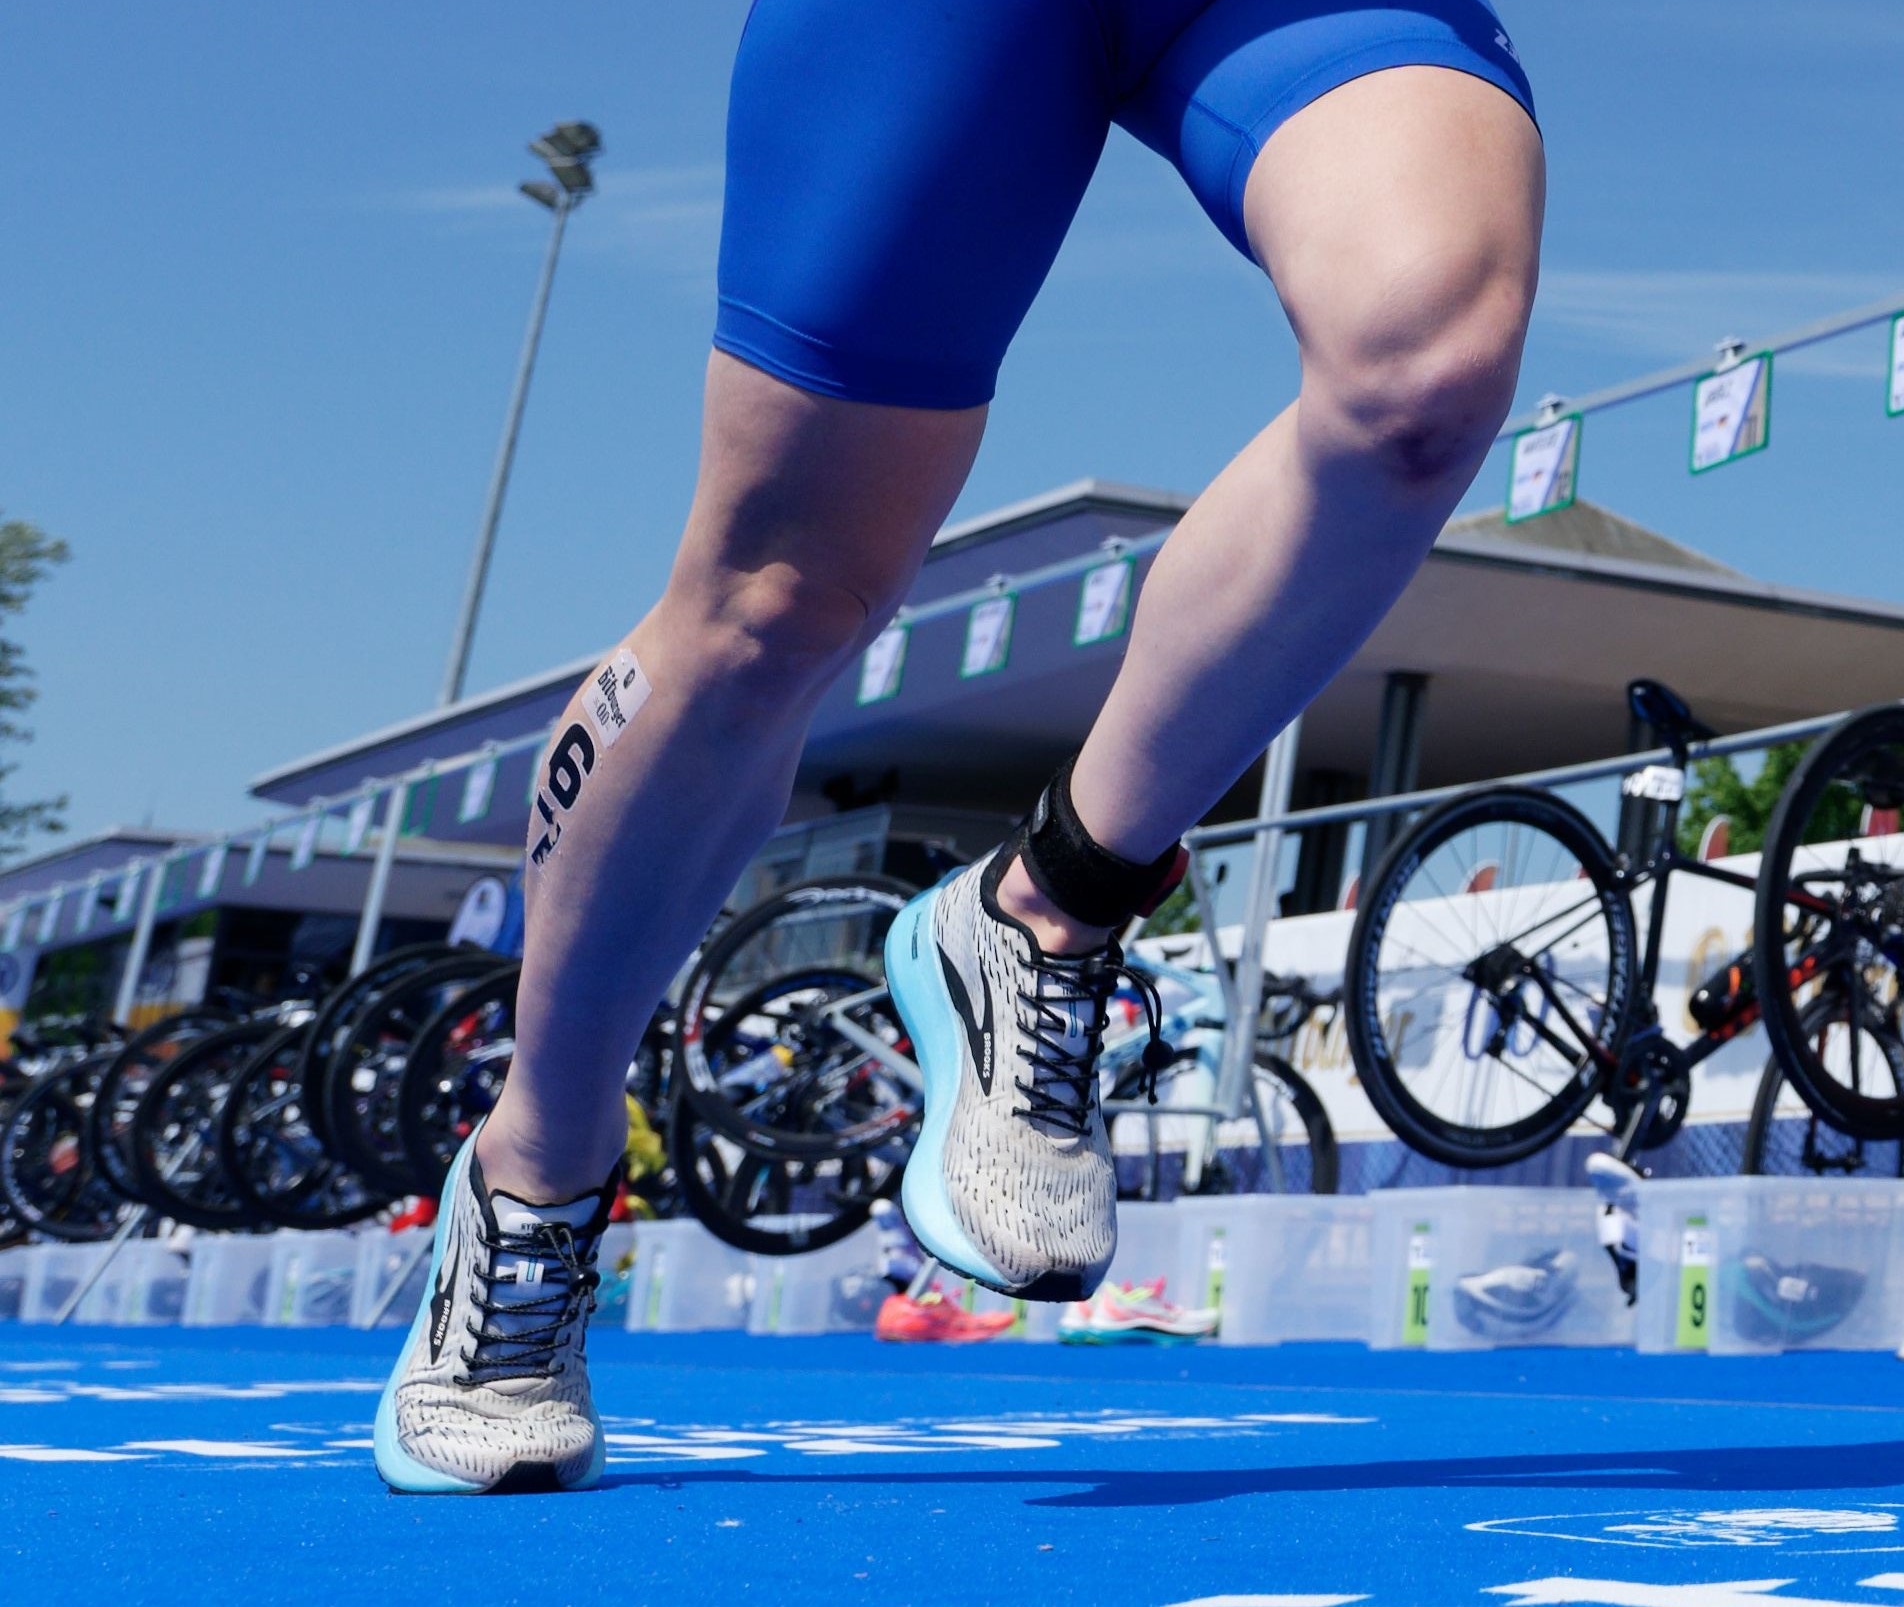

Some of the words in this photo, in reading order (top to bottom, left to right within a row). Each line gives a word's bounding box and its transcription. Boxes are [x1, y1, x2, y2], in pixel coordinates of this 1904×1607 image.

[981, 1032, 991, 1079] BROOKS
[434, 1298, 451, 1347] BROOKS
[1691, 1283, 1706, 1329] 9
